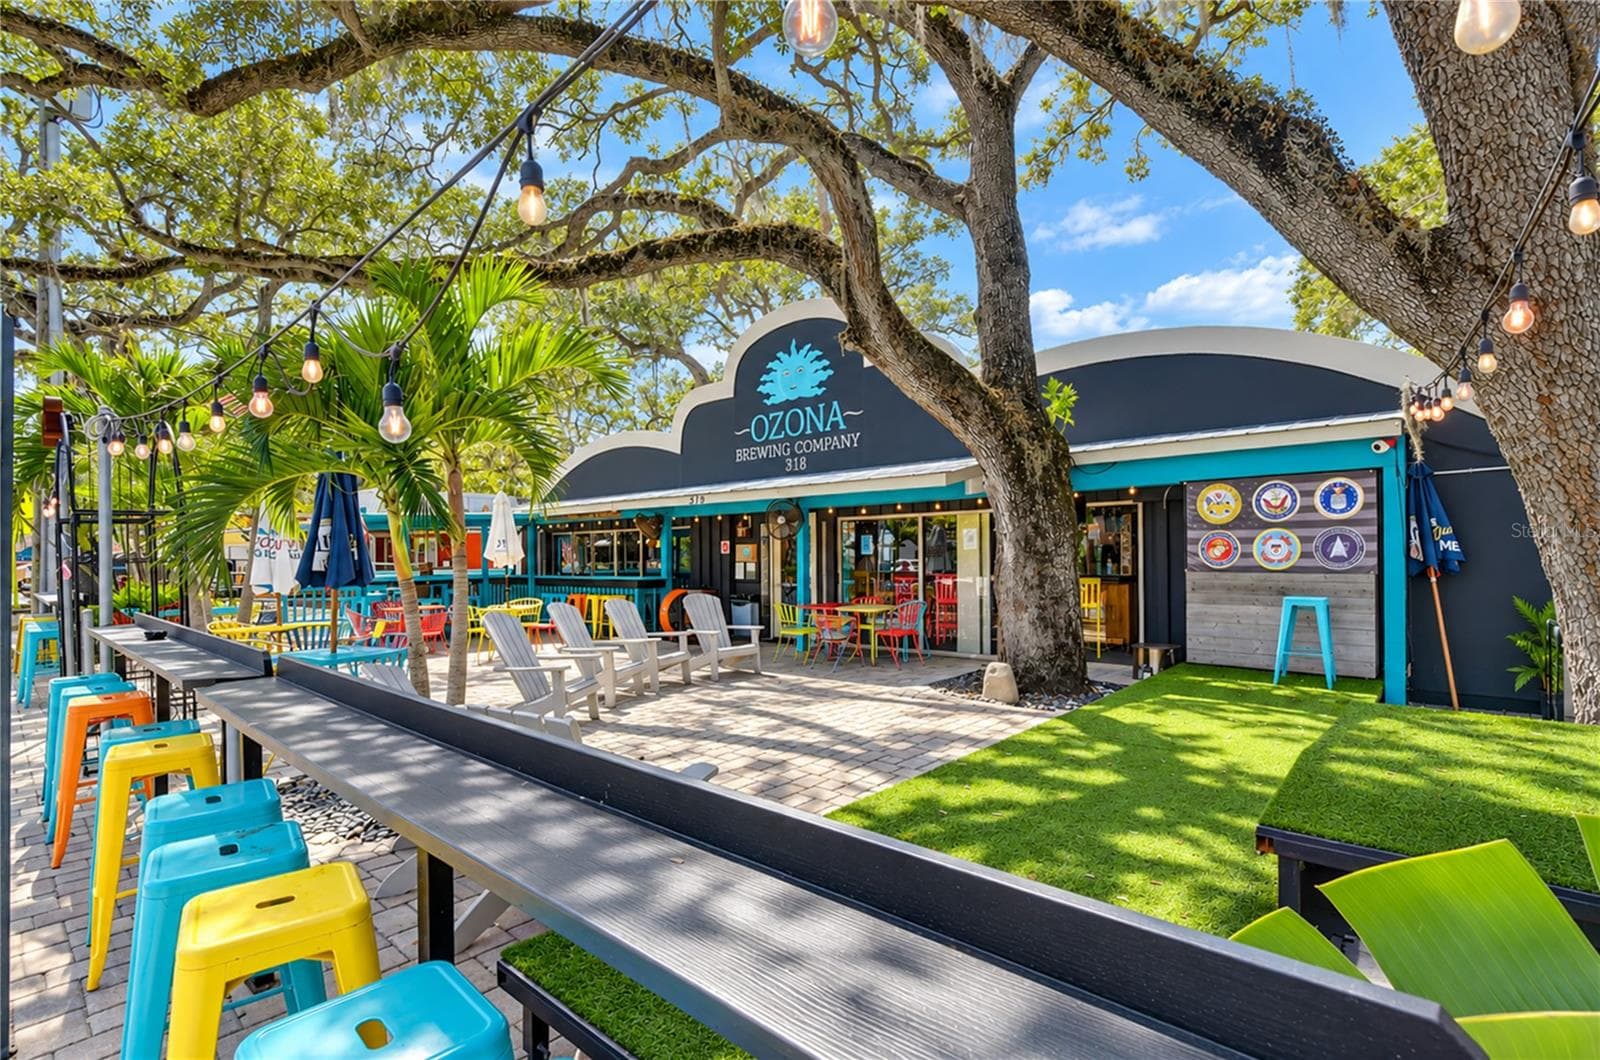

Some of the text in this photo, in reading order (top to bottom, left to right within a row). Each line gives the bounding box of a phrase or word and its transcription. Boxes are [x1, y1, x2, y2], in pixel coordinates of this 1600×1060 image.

[751, 401, 846, 442] OZONA
[735, 432, 861, 462] BREWING COMPANY
[786, 457, 807, 472] 318
